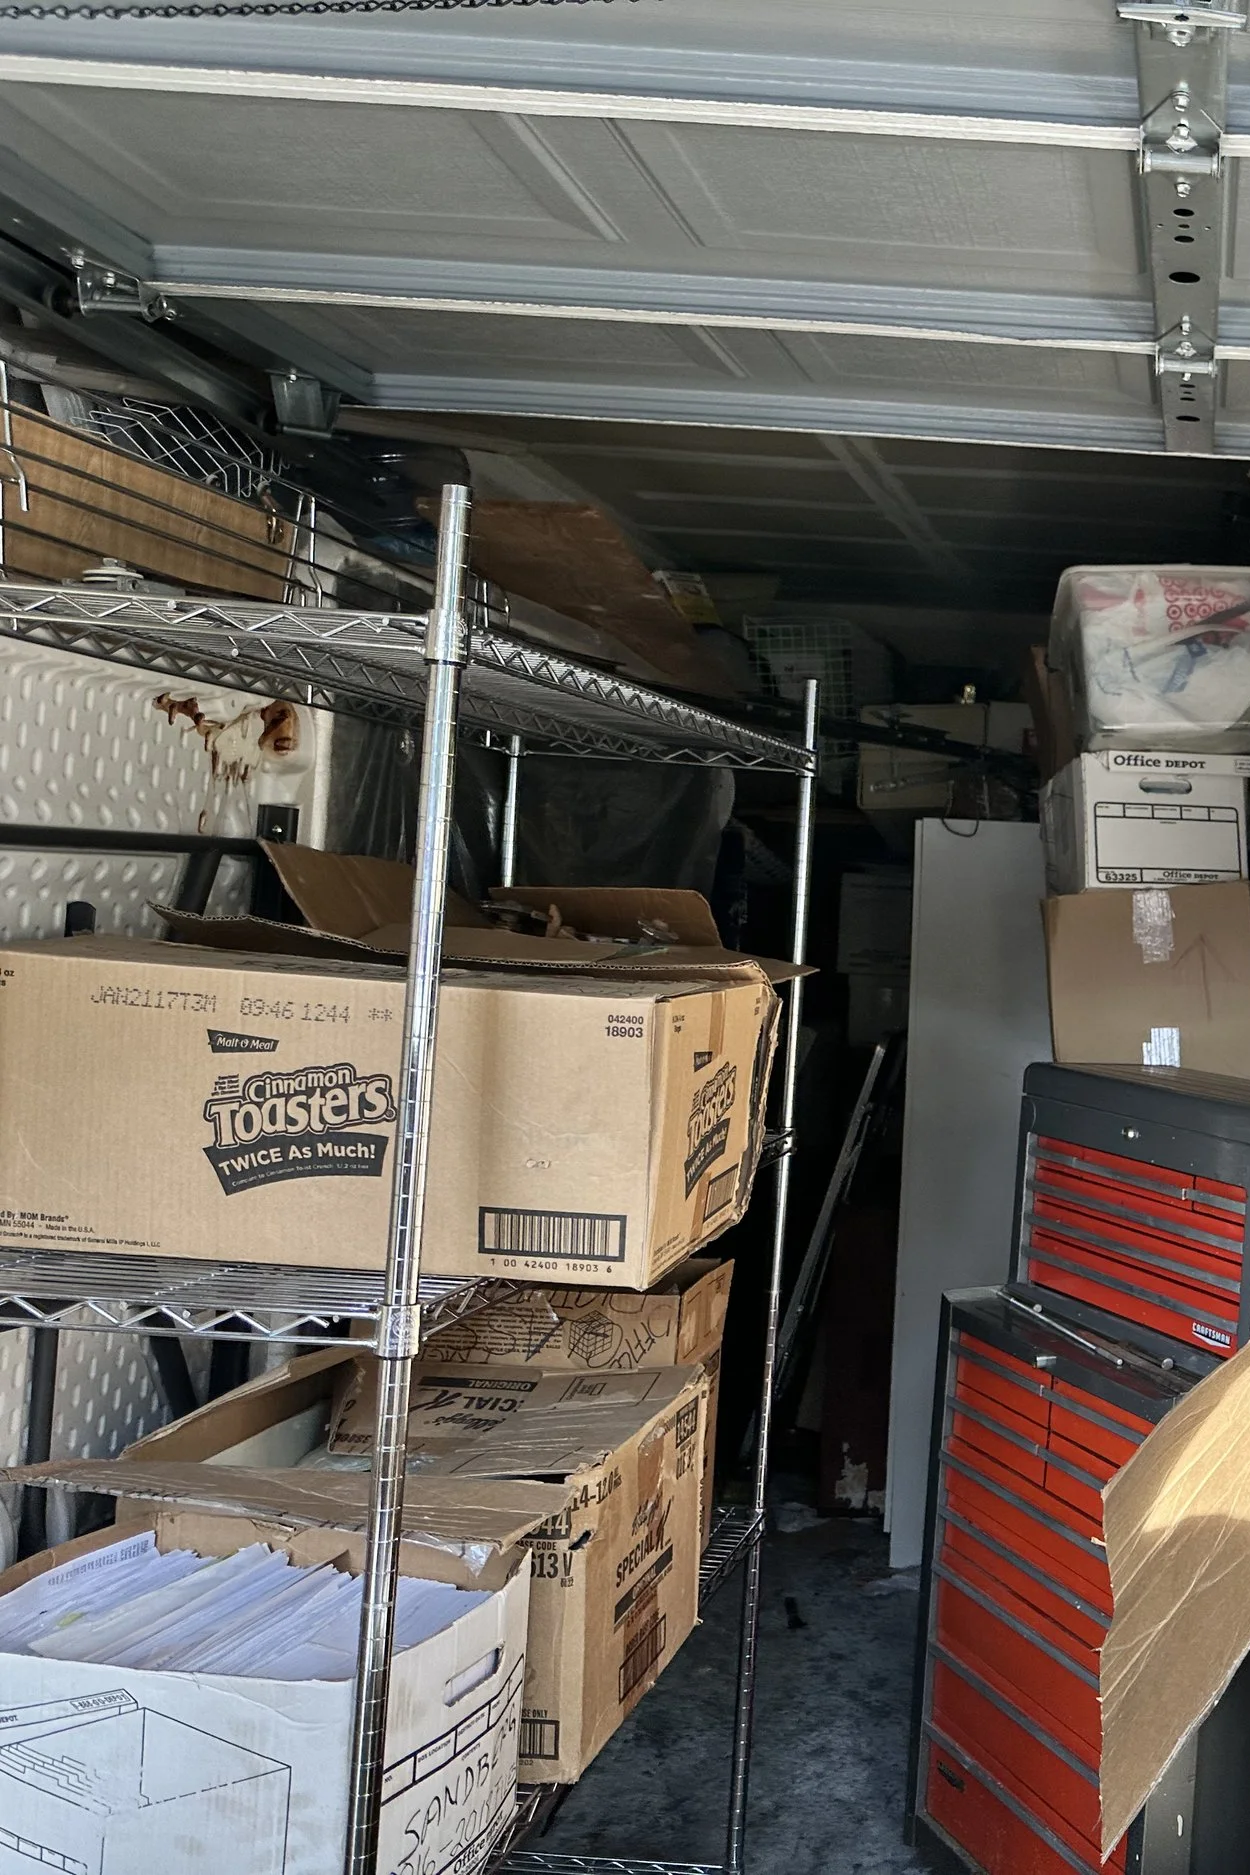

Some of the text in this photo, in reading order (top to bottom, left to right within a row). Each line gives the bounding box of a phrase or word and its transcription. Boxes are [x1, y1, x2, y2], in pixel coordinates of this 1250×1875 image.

[1113, 754, 1206, 769] Office DEPOT
[1105, 872, 1138, 881] 63325
[1163, 871, 1192, 879] Office
[301, 1002, 350, 1023] 1244
[608, 1014, 644, 1025] 042400
[605, 1026, 643, 1038] 18903
[248, 1067, 351, 1102] Cinnamon
[209, 1079, 390, 1147] Toasters
[218, 1142, 376, 1176] TWICE As Much!
[13, 1220, 35, 1228] 55044
[503, 1259, 517, 1267] 00
[524, 1260, 558, 1270] 42400
[566, 1263, 599, 1273] 18903
[606, 1265, 612, 1273] 6
[1192, 1321, 1231, 1345] CRAFTSMAN
[469, 1379, 532, 1391] ORIGINAL
[536, 1541, 558, 1550] CODE
[615, 1530, 656, 1589] SPECIAL
[453, 1837, 486, 1875] Office
